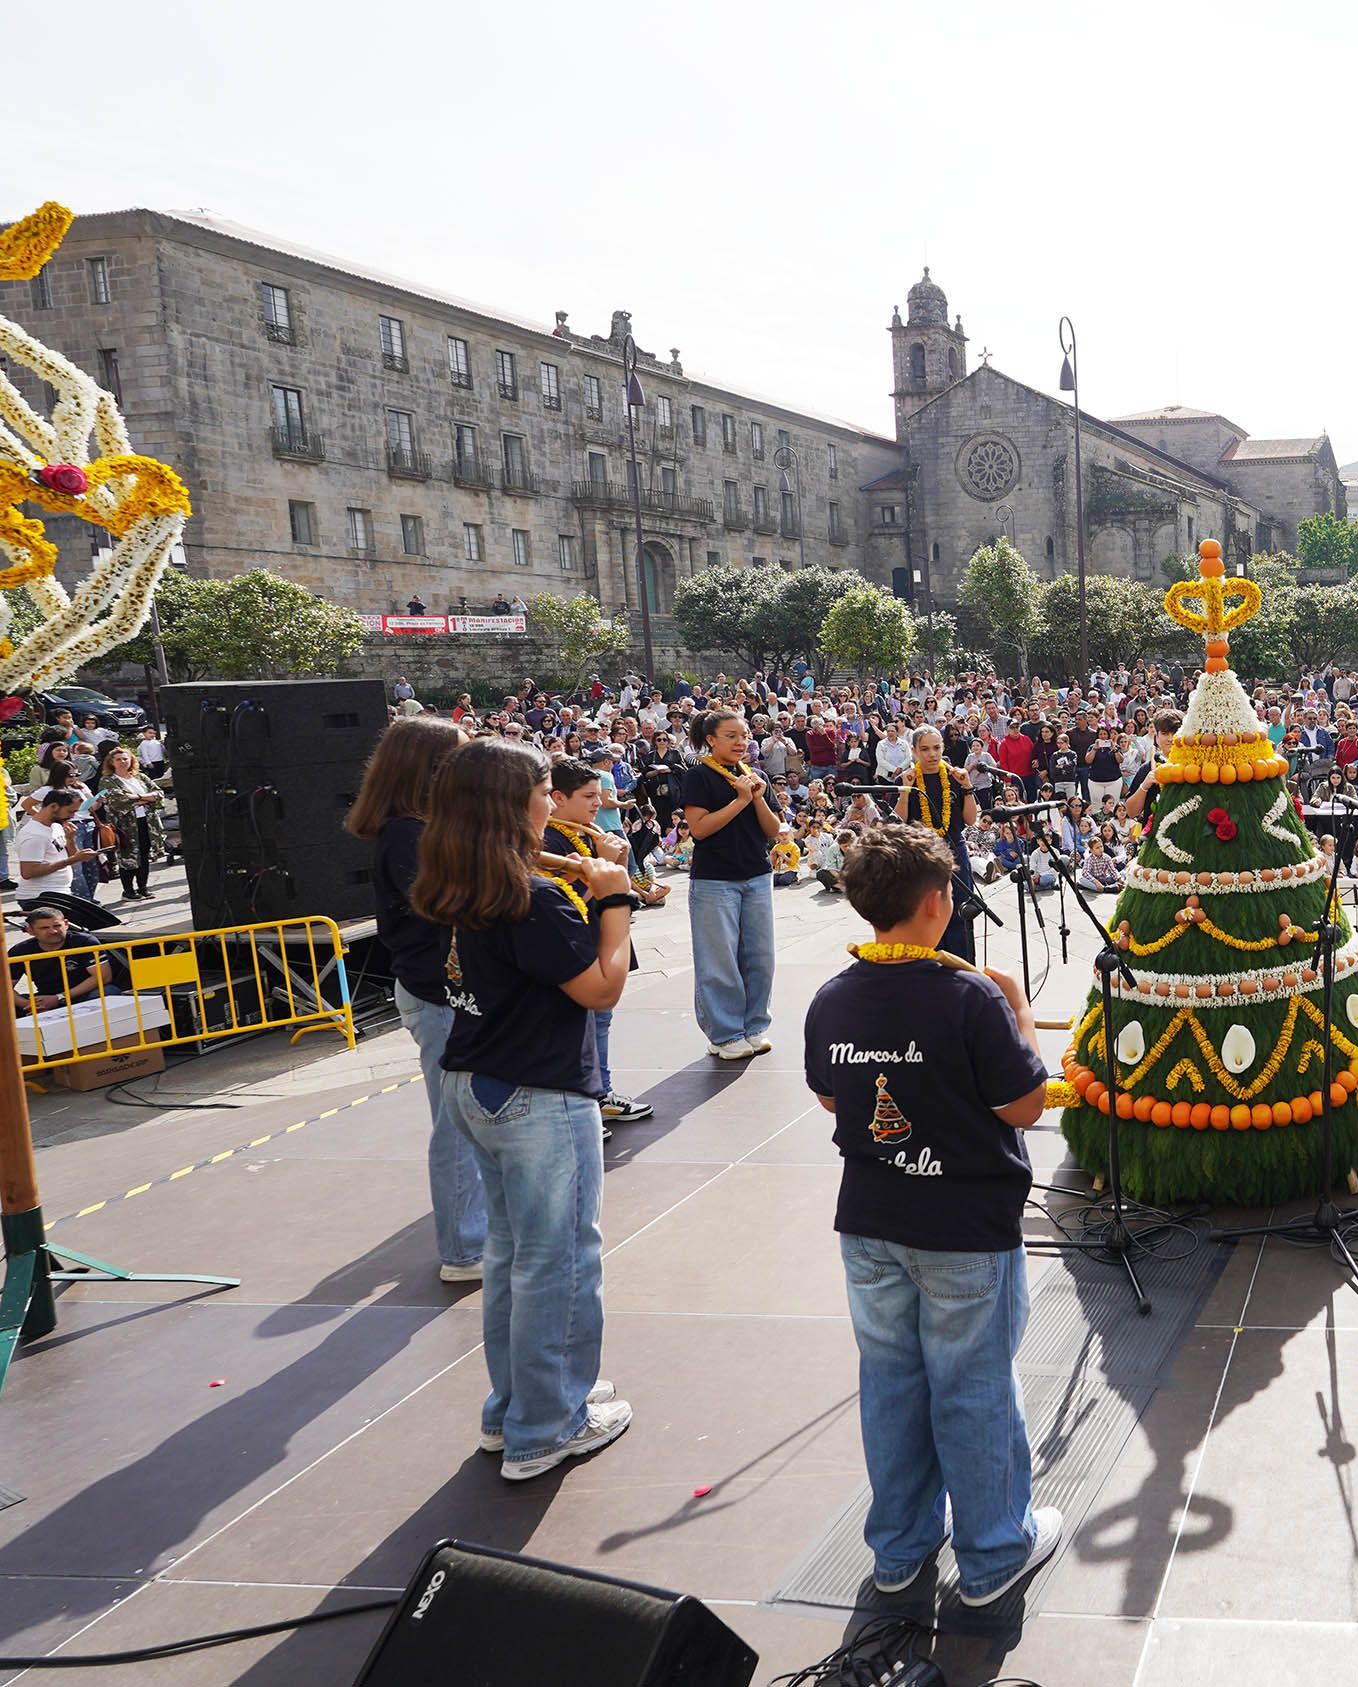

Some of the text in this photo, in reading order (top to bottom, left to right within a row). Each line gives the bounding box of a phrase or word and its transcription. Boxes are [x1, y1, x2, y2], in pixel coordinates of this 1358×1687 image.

[829, 1040, 923, 1064] Marcos da
[411, 1569, 446, 1620] NEXO
